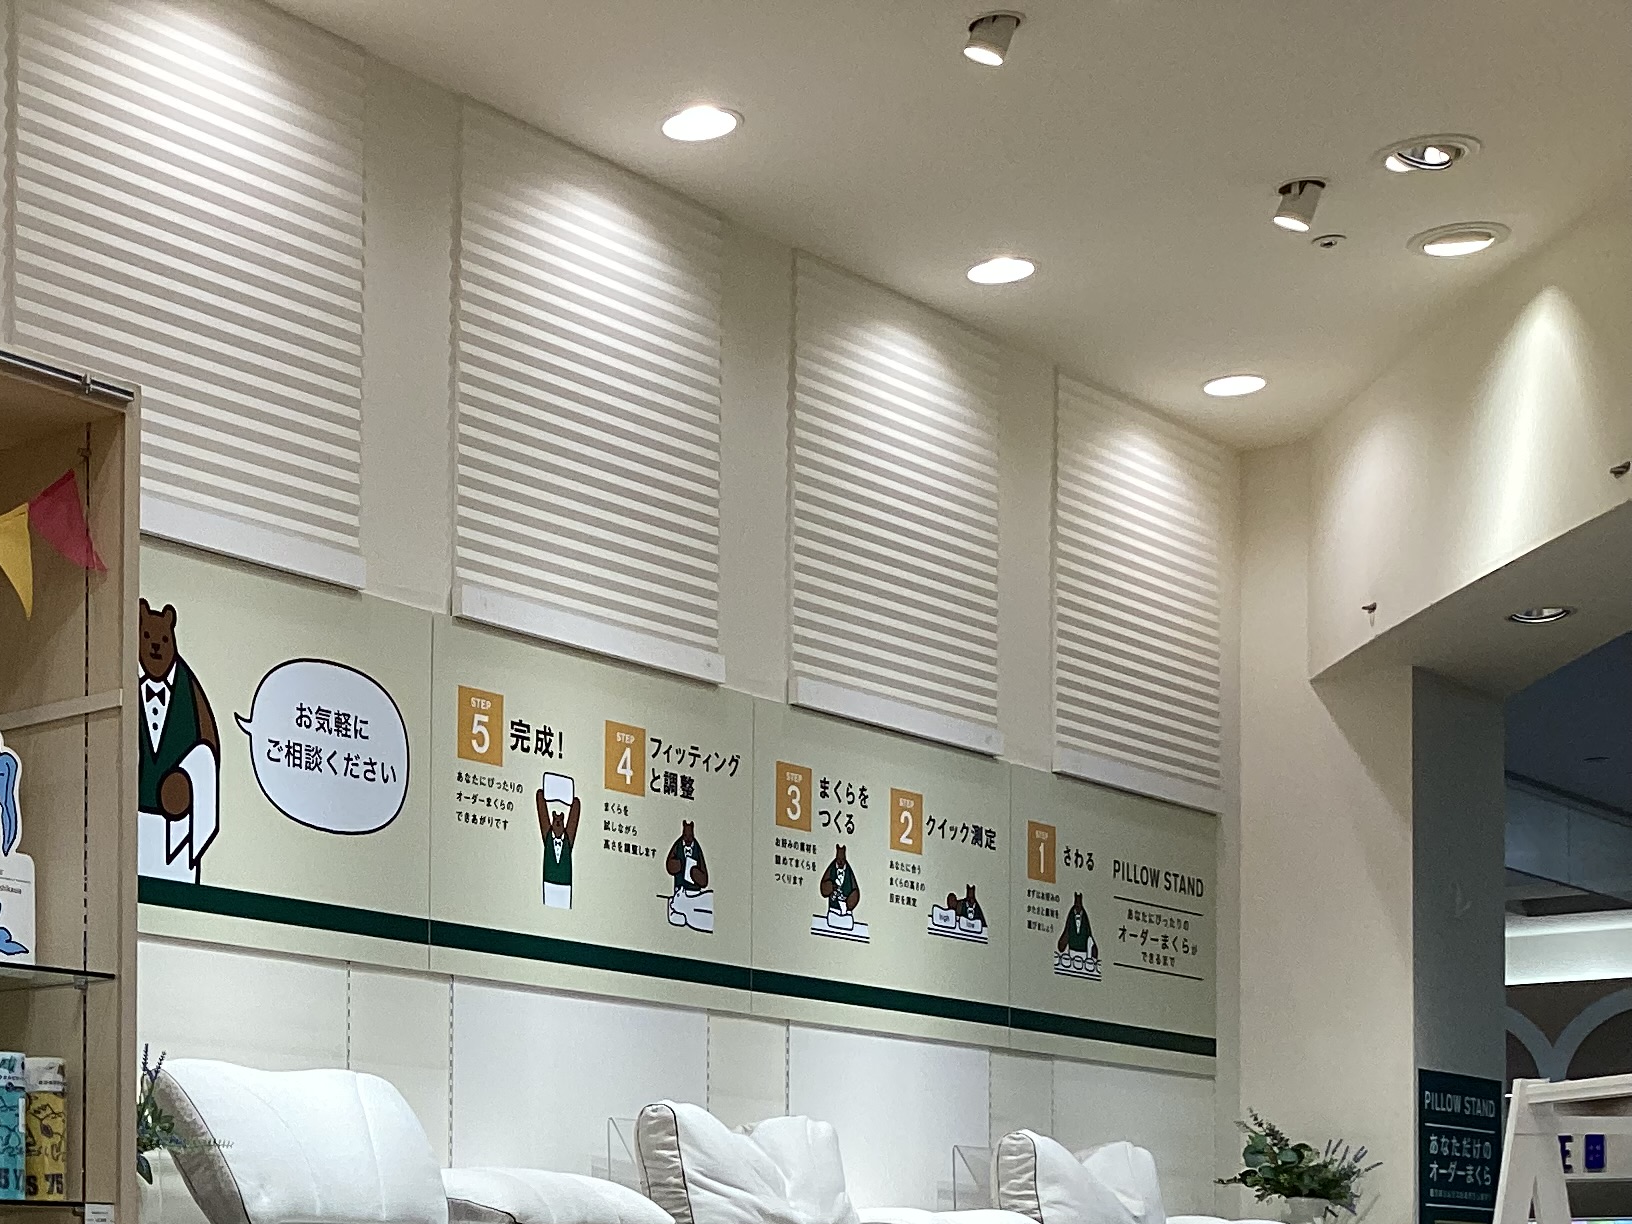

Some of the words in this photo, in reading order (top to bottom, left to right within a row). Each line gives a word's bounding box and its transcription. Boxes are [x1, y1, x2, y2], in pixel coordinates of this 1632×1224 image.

[470, 697, 492, 710] STEP
[295, 702, 370, 741] お気軽に
[471, 713, 490, 754] 5
[616, 731, 635, 745] STEP
[266, 738, 398, 784] ご相談ください
[616, 746, 634, 785] 4
[649, 737, 741, 778] フィッティング
[649, 767, 695, 801] と調整
[819, 776, 869, 809] まくらを
[456, 790, 514, 812] オーダーまくらの
[604, 802, 629, 817] まくらを
[786, 784, 802, 821] 3
[455, 811, 509, 831] できあがりです
[603, 820, 638, 837] 試しながら
[818, 810, 855, 835] つくる
[899, 810, 914, 846] 2
[925, 814, 997, 851] クイック測定
[603, 839, 657, 859] 高さを調整します
[1038, 842, 1045, 875] 1
[1063, 845, 1095, 872] さわる
[774, 872, 804, 887] つくります
[1113, 859, 1161, 889] PILLOW
[1163, 870, 1205, 898] STAND
[1424, 1090, 1462, 1114] PILLOW
[1463, 1095, 1496, 1118] STAND
[1429, 1133, 1492, 1160] あなただけの
[1429, 1160, 1492, 1187] オーダーまくら
